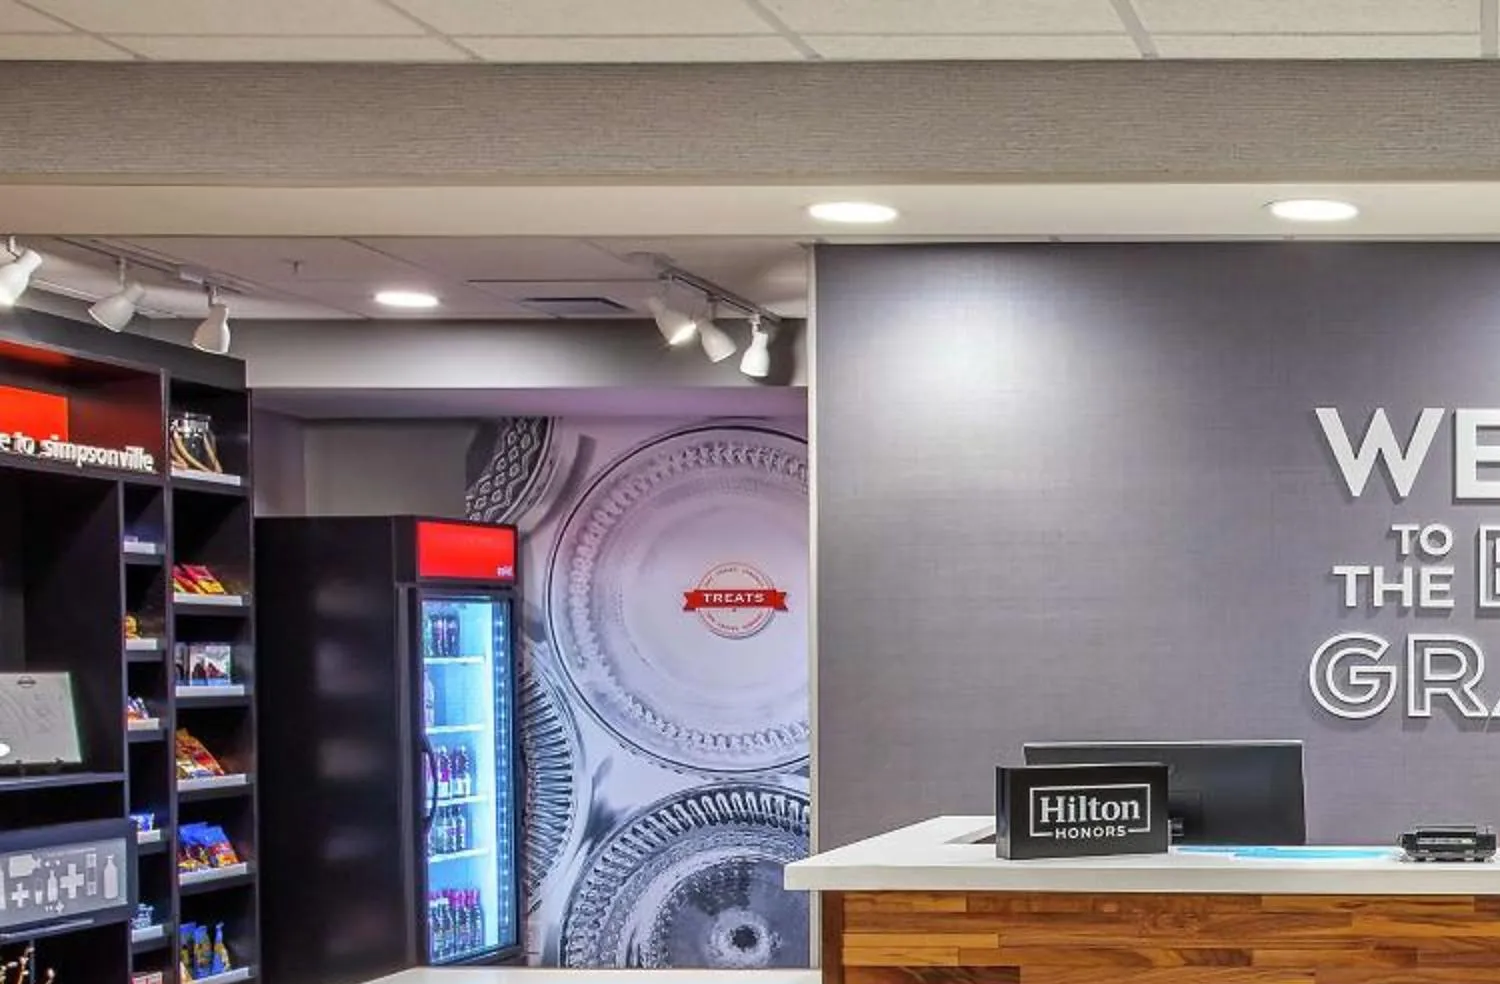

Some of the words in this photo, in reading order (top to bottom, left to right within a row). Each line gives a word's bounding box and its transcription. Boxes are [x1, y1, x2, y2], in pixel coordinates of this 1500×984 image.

[13, 432, 35, 454] to
[39, 434, 156, 472] simpsonville
[1391, 523, 1455, 558] TO
[703, 592, 766, 604] TREATS
[1333, 565, 1456, 609] THE
[1039, 795, 1141, 823] Hilton
[1055, 825, 1127, 840] HONORS
